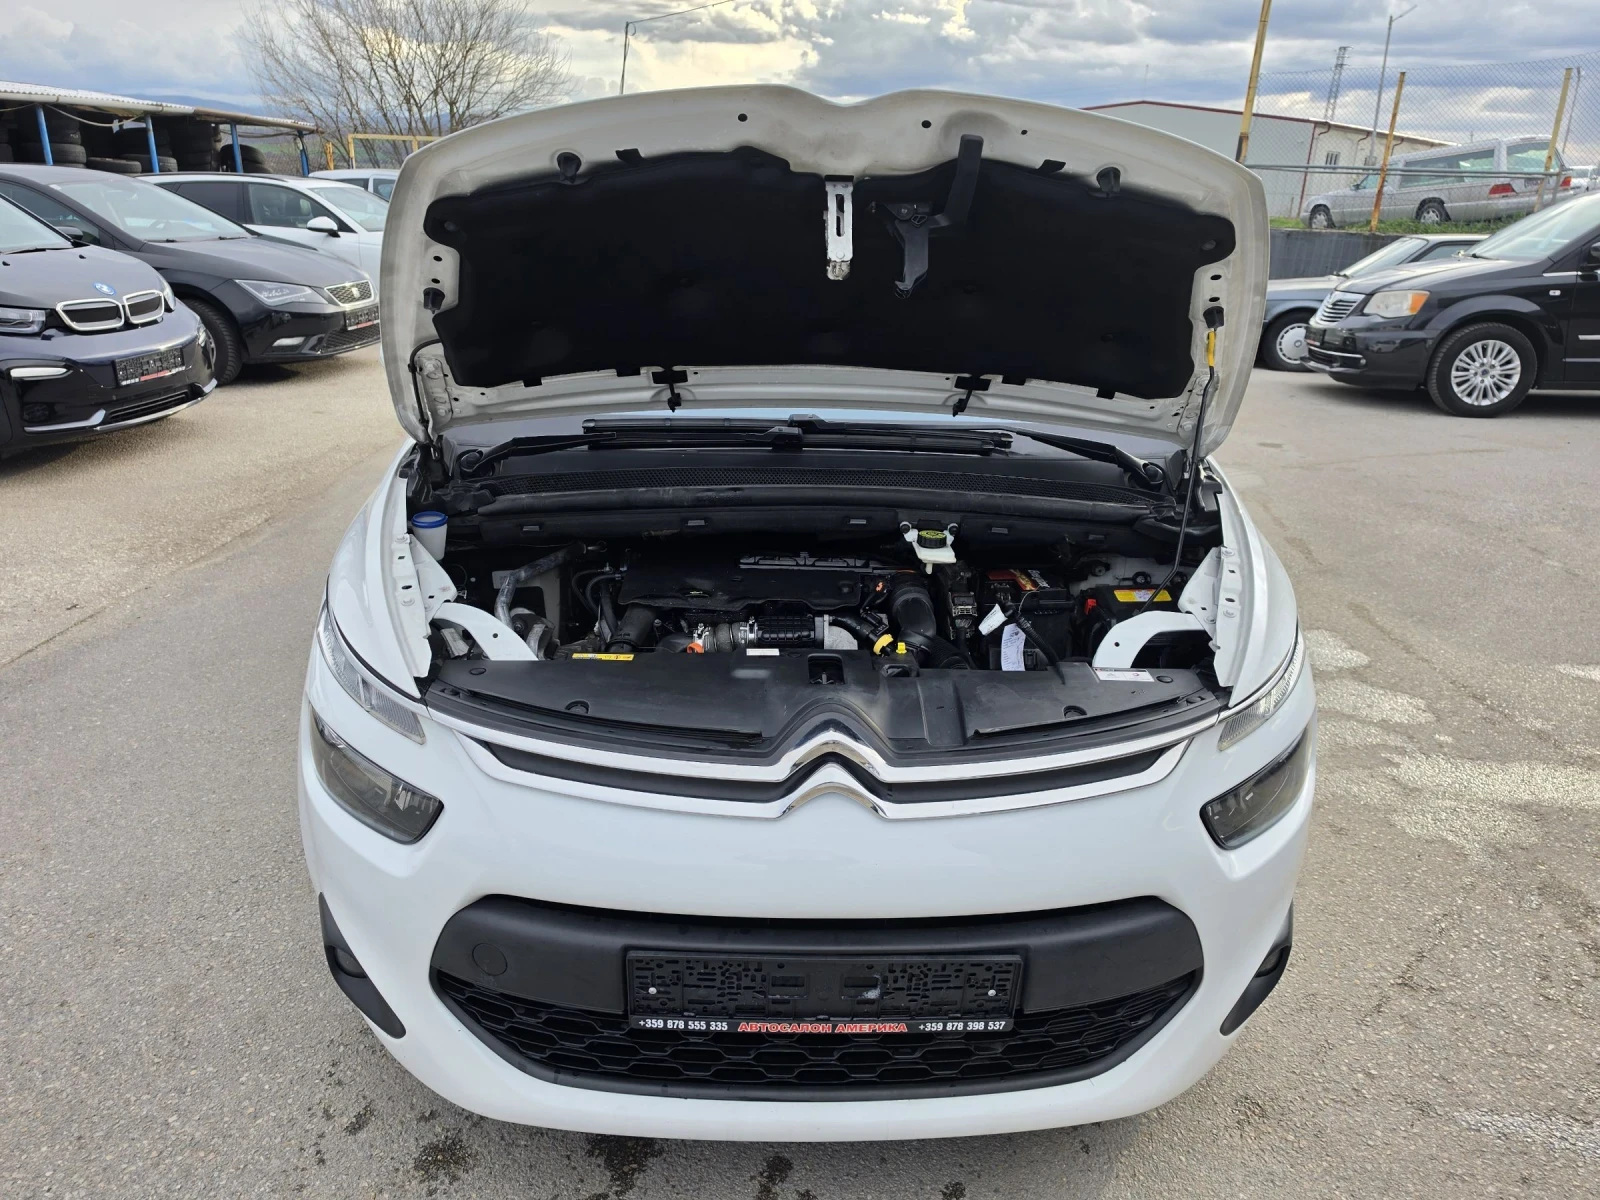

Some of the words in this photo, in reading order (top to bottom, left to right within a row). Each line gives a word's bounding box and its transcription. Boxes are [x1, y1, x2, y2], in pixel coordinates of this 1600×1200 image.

[638, 1018, 664, 1028] +359
[667, 1019, 685, 1029] 878
[687, 1020, 706, 1030] 555
[709, 1021, 728, 1031] 335
[738, 1022, 832, 1033] АВТОСАЛОН
[834, 1022, 908, 1033] АМЕРИКА
[918, 1022, 943, 1032] +359
[946, 1021, 964, 1031] 878
[966, 1021, 985, 1031] 398
[987, 1020, 1006, 1030] 537
